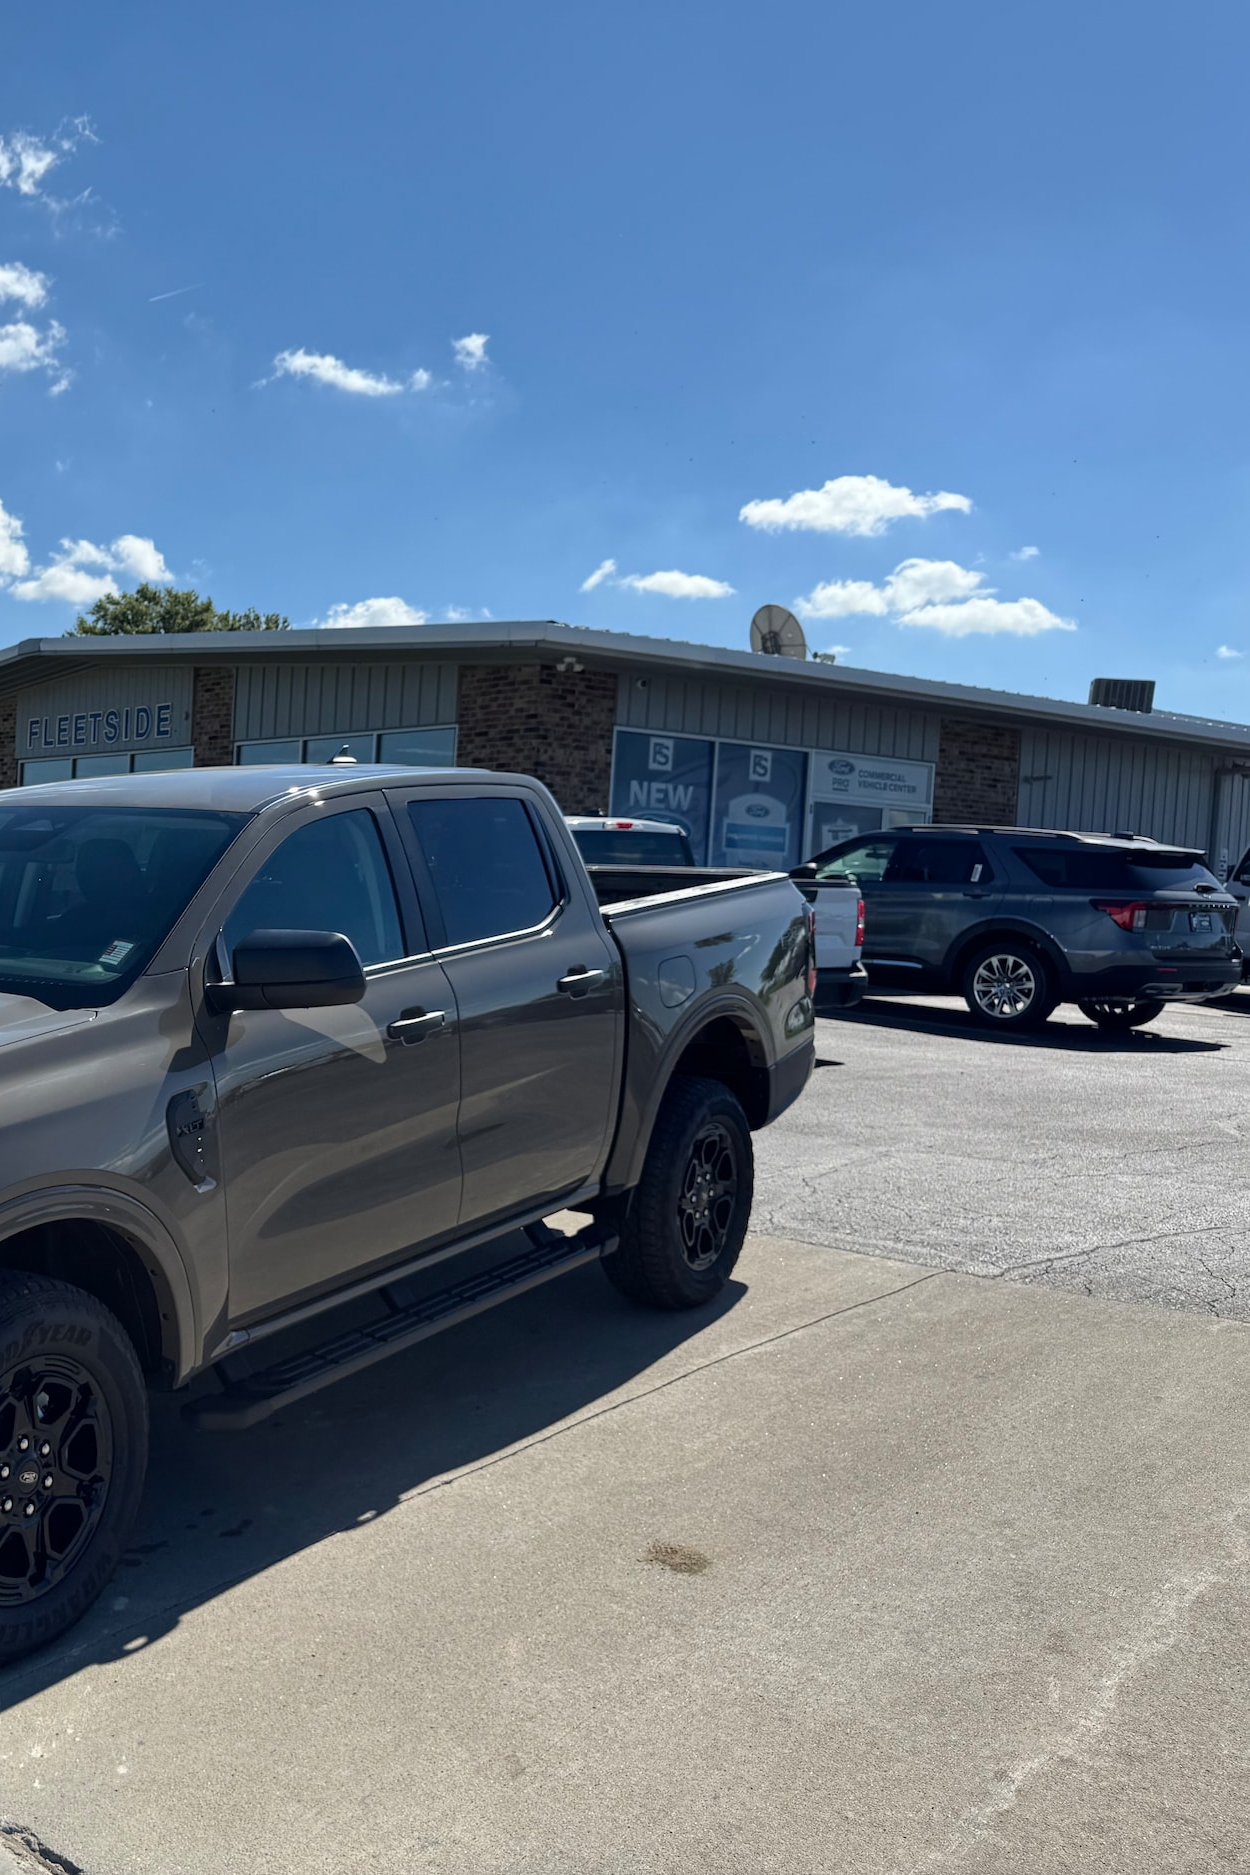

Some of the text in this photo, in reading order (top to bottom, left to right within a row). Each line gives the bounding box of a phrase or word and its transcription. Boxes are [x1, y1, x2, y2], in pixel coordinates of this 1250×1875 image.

[27, 702, 172, 749] FLEETSIDE
[832, 777, 849, 788] PRO
[858, 769, 907, 783] COMMERCIAL
[857, 779, 917, 794] VEHICLE CENTER
[629, 780, 694, 812] NEW
[177, 1119, 204, 1137] XLT
